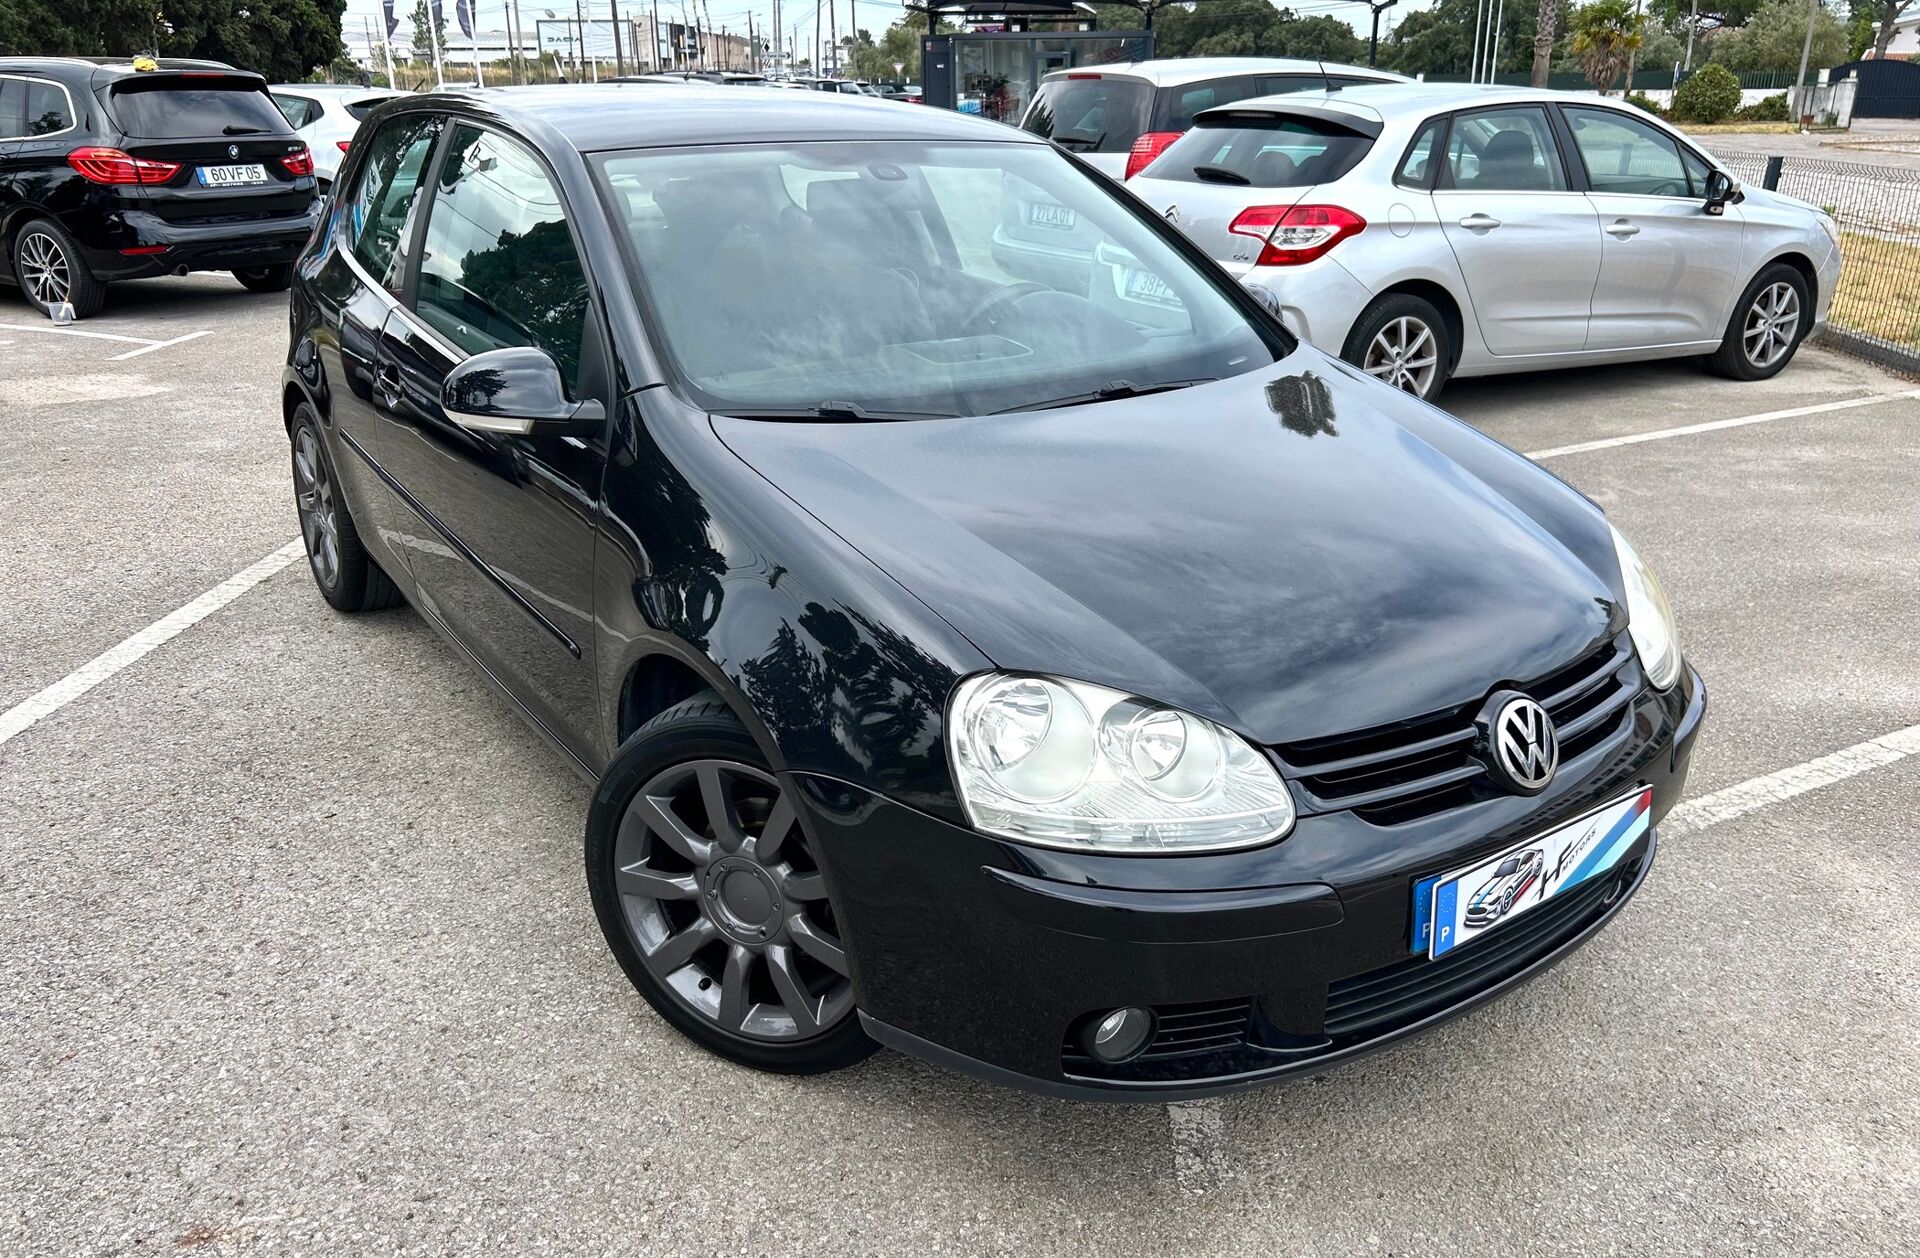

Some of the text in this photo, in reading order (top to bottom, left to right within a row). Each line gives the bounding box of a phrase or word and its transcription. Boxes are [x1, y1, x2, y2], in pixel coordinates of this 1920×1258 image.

[1561, 828, 1596, 873] MOTORS
[1422, 922, 1431, 938] P
[1441, 925, 1450, 942] P
